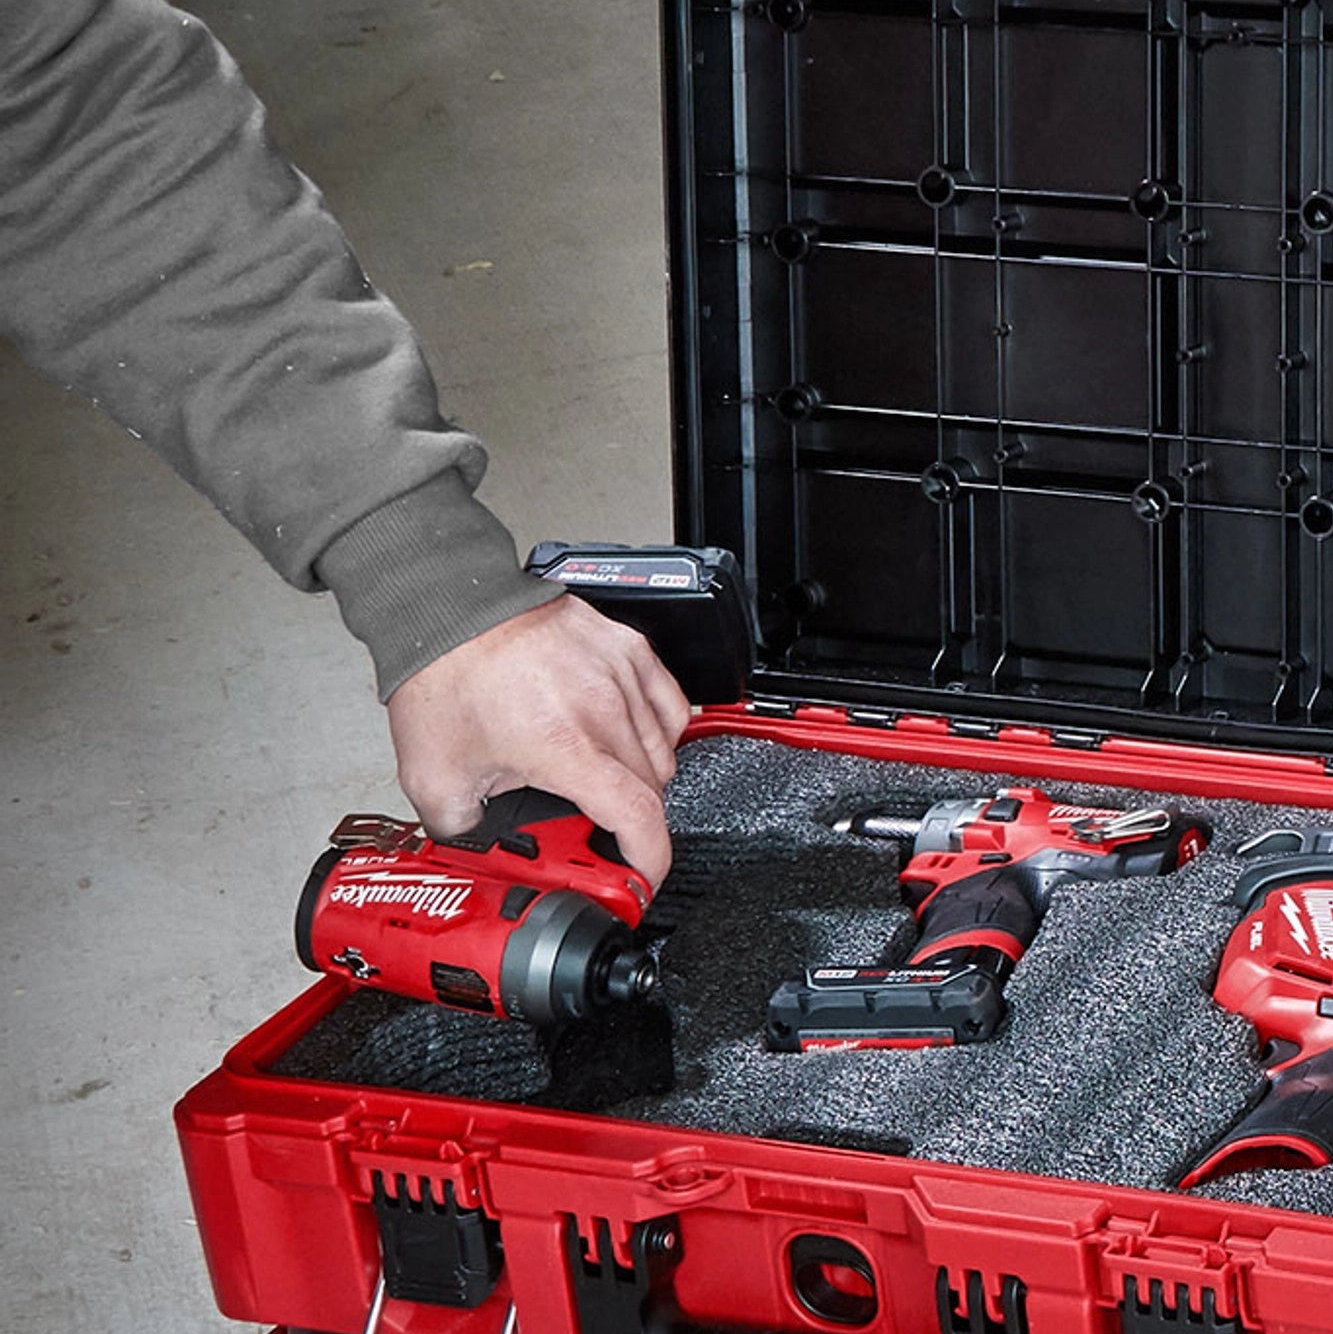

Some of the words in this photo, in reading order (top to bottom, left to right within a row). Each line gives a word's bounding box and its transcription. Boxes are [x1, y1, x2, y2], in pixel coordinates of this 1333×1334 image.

[341, 855, 400, 866] FUEL
[330, 884, 472, 921] Milwaukee
[1249, 921, 1264, 952] FUEL
